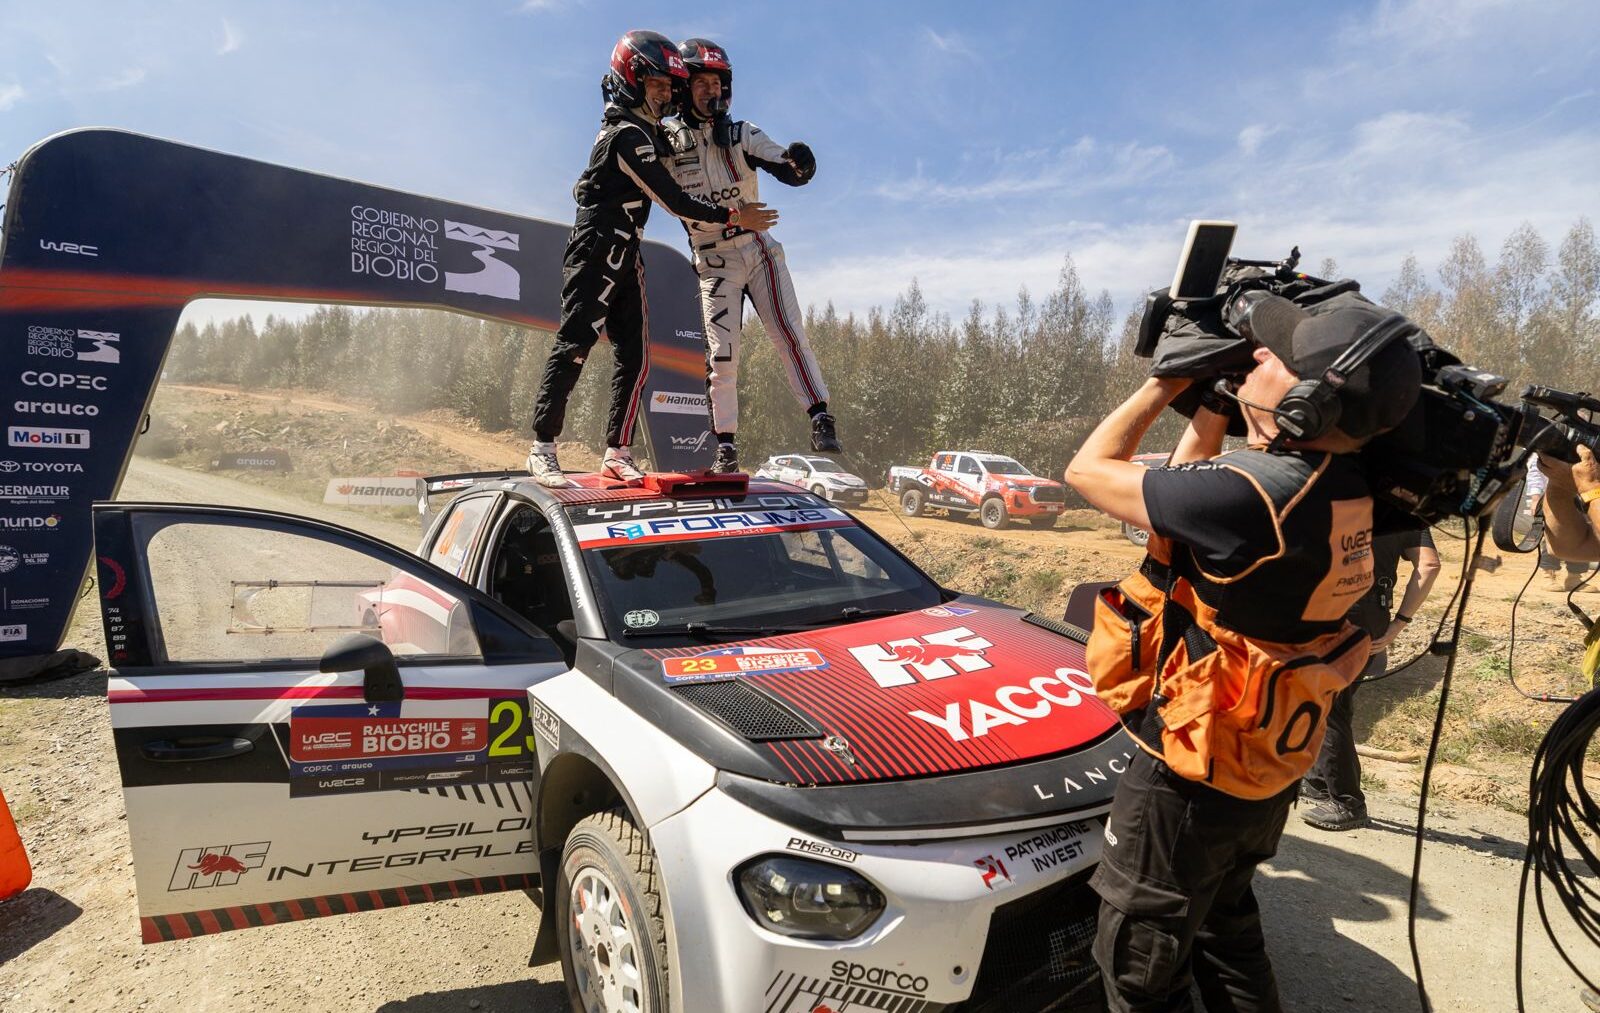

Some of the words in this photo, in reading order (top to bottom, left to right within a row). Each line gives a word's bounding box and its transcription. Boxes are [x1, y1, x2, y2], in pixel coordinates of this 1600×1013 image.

[351, 205, 439, 233] GOBIERNO
[351, 220, 439, 250] REGIONAL
[40, 239, 98, 256] WRC
[351, 237, 406, 258] REGION
[414, 247, 438, 264] DEL
[351, 252, 439, 284] BIOBIO
[28, 325, 75, 336] GOBIERNO
[28, 332, 74, 344] REGIONAL
[675, 329, 702, 340] WRC
[28, 346, 74, 358] BIOBIO
[60, 341, 73, 349] DEL
[21, 371, 107, 390] COPEC
[14, 401, 99, 416] arauco
[666, 395, 707, 407] Hankoo
[14, 431, 62, 444] Mobil
[23, 462, 84, 472] TOYOTA
[236, 457, 276, 467] arauco
[351, 485, 416, 497] Hankoo
[587, 495, 819, 519] YPSILON
[648, 508, 827, 533] FORUM8
[626, 611, 658, 628] FIA
[3, 628, 20, 636] FIA
[681, 658, 718, 673] 23
[907, 667, 1097, 742] YACCO
[362, 721, 450, 736] RALLYCHILE
[302, 732, 352, 744] WRC
[362, 731, 450, 753] BIOBÍO
[303, 765, 333, 773] COPEC
[341, 762, 373, 770] arauco
[319, 778, 365, 788] WRC2
[1004, 821, 1091, 861] PATRIMOINE
[267, 841, 533, 881] INTEGRALE
[1031, 840, 1084, 873] INVEST
[830, 960, 929, 993] sparco
